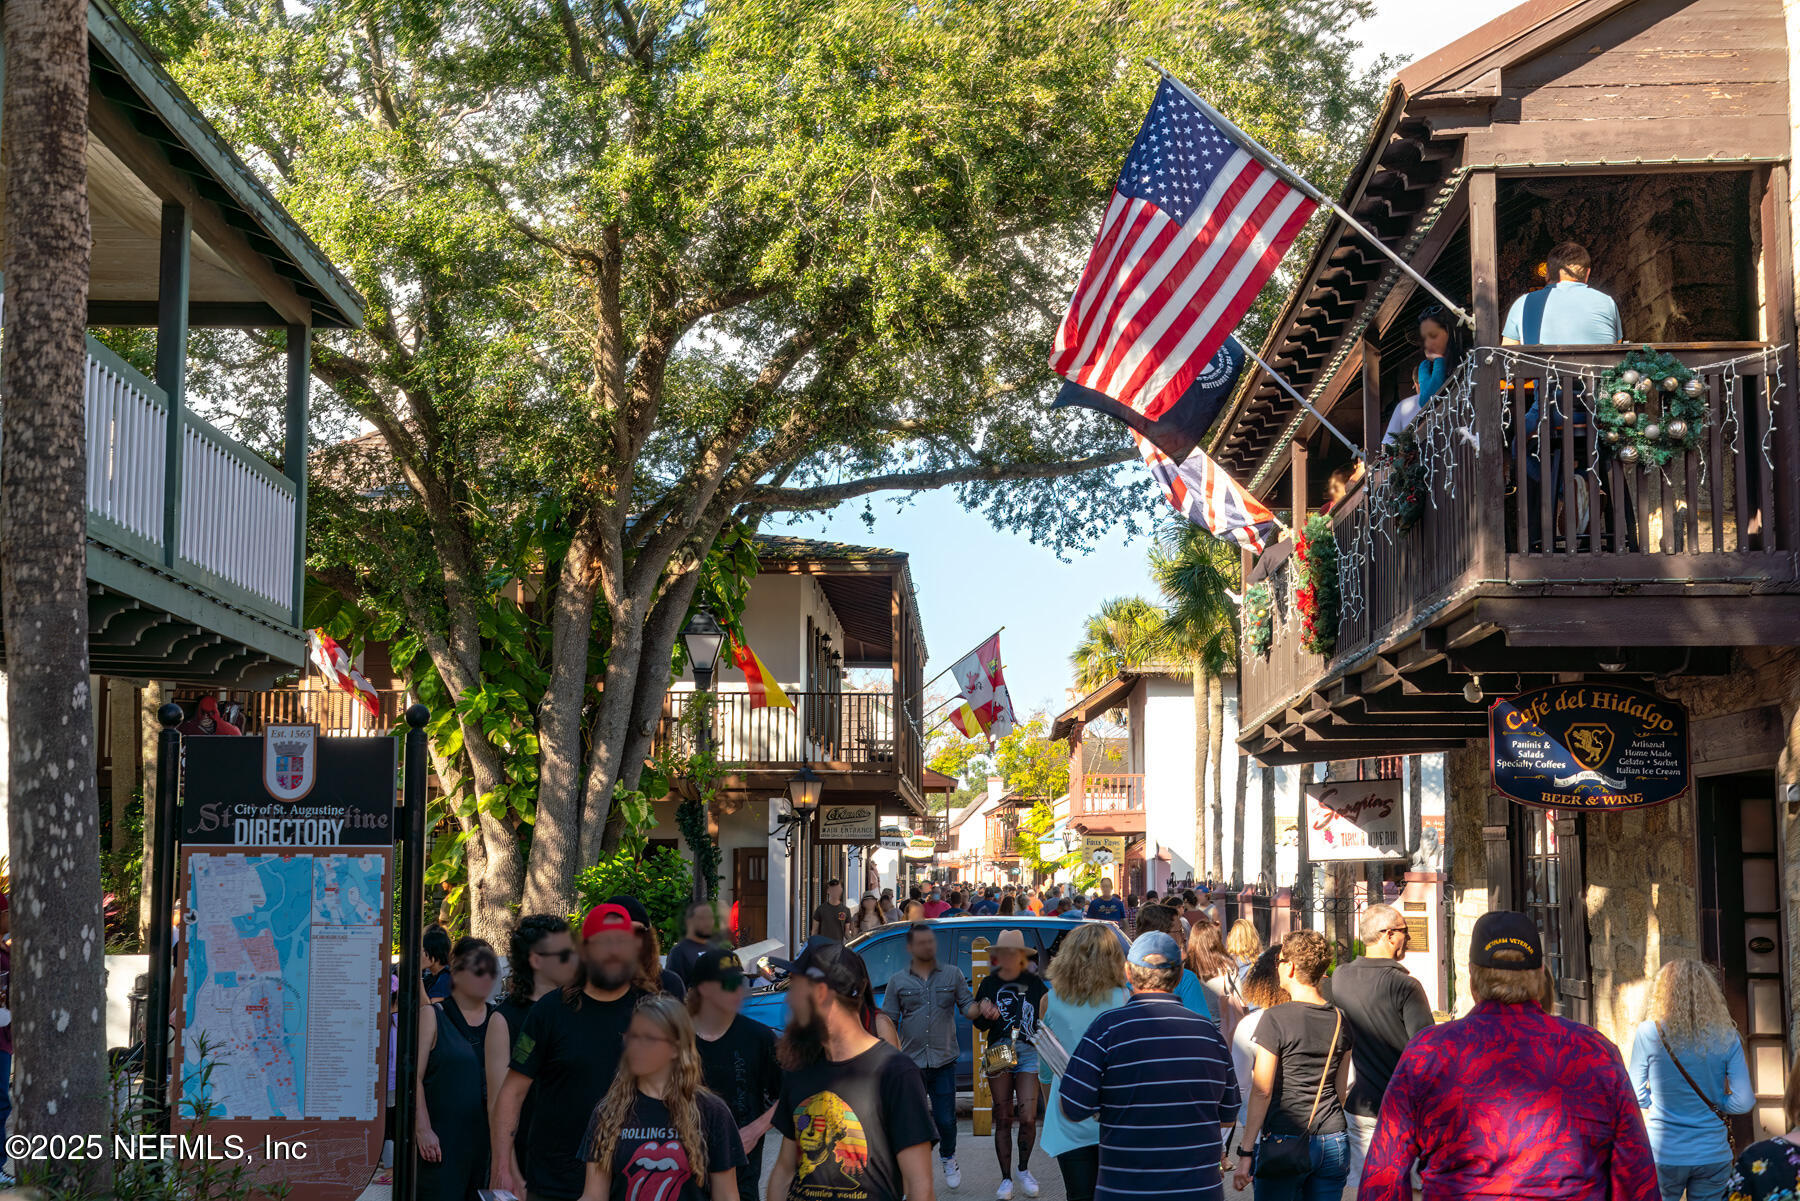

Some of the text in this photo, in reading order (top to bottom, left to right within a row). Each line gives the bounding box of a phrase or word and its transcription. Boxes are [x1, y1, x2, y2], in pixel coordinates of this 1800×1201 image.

[1505, 689, 1674, 731] Café del Hidalgo
[270, 729, 311, 738] Est. 1565
[1512, 740, 1551, 749] Paninis &
[1631, 740, 1665, 748] Artisanal
[1518, 750, 1545, 758] Salads
[1625, 749, 1672, 757] Home Made
[1496, 759, 1566, 769] Specialty Coffees
[1618, 758, 1678, 767] Gelato Sorbet
[1616, 766, 1681, 775] Italian Ice Cream
[1541, 791, 1644, 806] BEER & WINE
[234, 803, 259, 818] City
[260, 803, 272, 815] of
[273, 804, 287, 815] St.
[290, 804, 345, 818] Augustine
[234, 818, 344, 846] DIRECTORY
[1086, 838, 1102, 846] Faux
[1509, 937, 1535, 955] VETERAN
[621, 1127, 666, 1140] ROLLING
